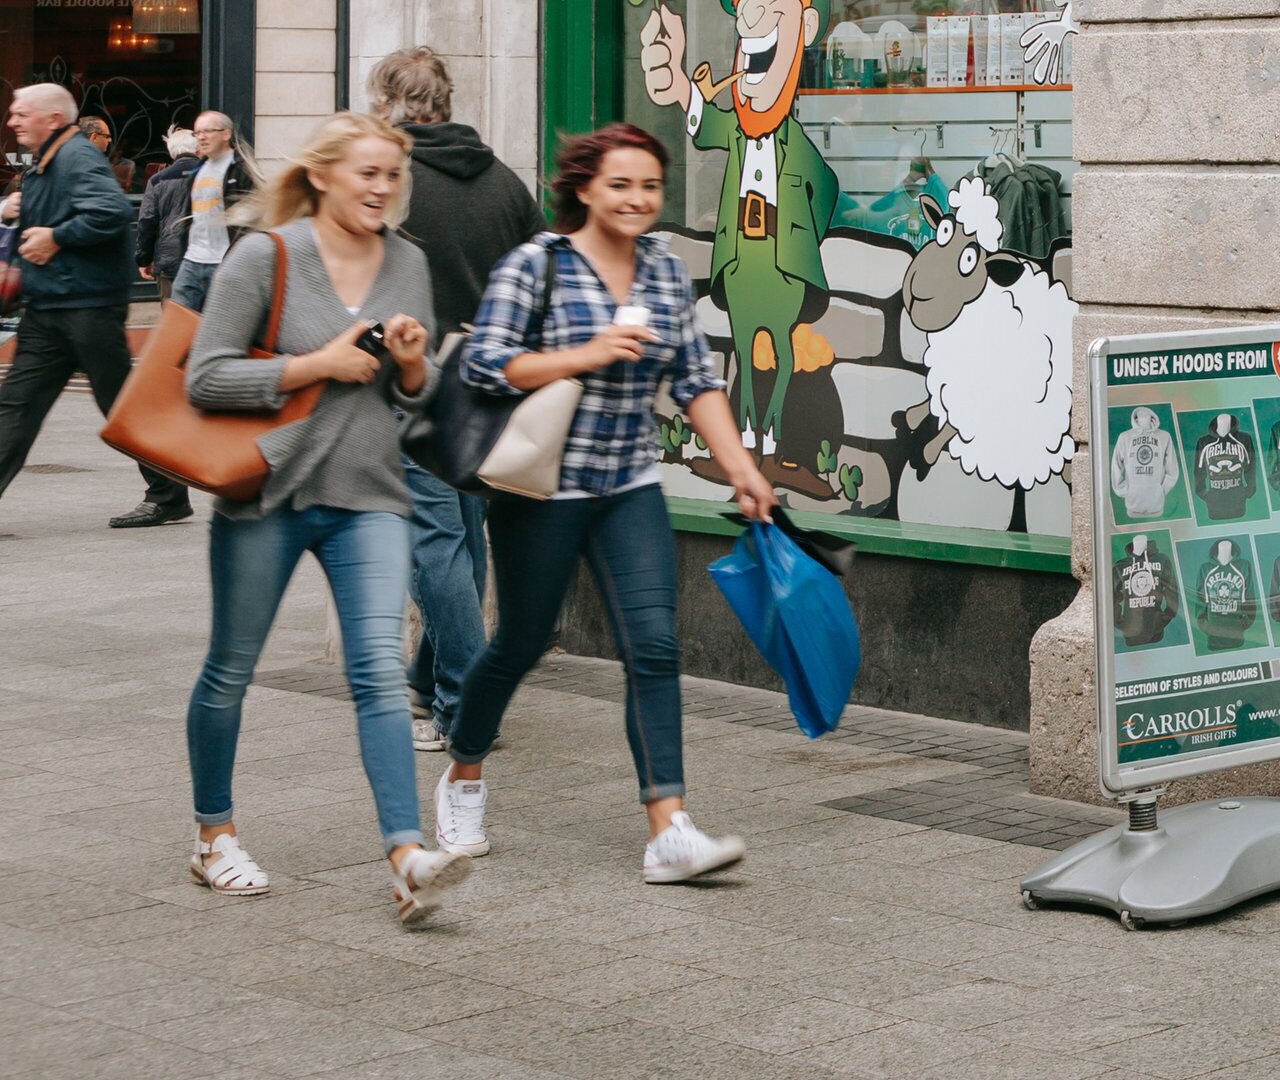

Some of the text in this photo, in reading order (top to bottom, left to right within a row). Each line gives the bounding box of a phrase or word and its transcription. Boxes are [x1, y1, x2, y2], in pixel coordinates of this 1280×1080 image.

[1113, 355, 1169, 378] UNISEX
[1173, 351, 1224, 374] HOODS
[1227, 349, 1267, 370] FROM
[1115, 666, 1258, 699] SELECTION OF STYLES AND COLOURS
[1122, 703, 1237, 740] CARROLLS
[1191, 729, 1237, 745] IRISH GIFTS
